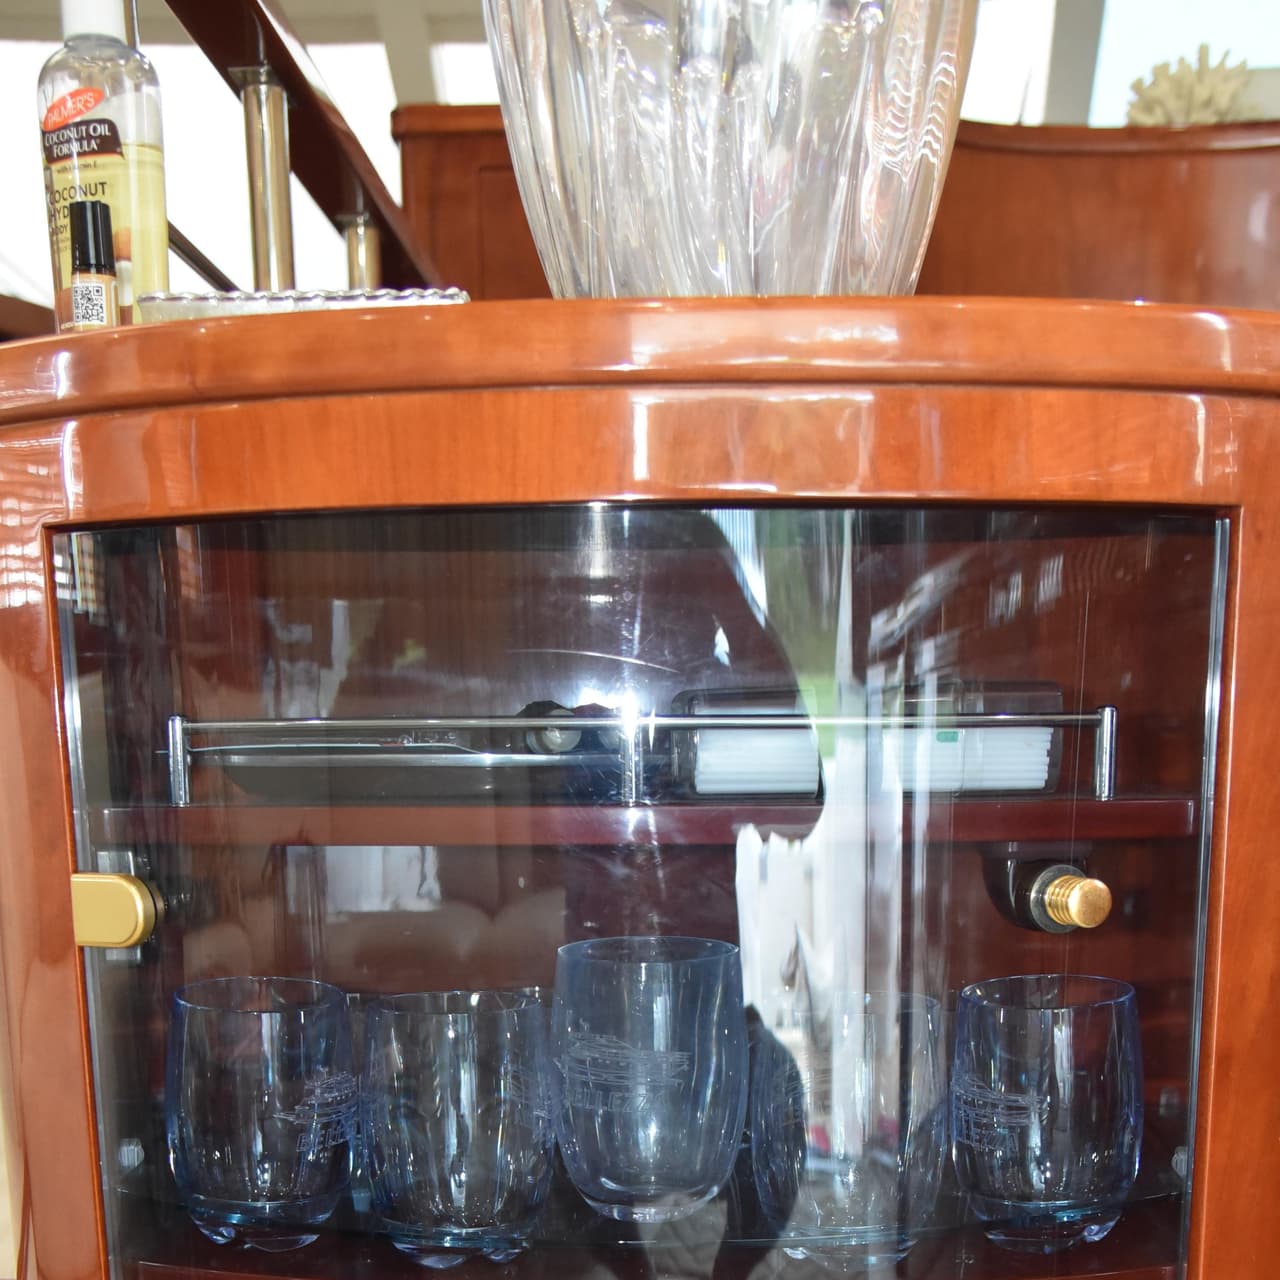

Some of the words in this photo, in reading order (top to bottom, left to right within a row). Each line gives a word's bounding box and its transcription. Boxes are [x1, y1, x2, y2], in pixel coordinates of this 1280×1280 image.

[47, 92, 95, 129] PALMER'S
[45, 126, 86, 147] COCONUT
[89, 123, 111, 137] OIL
[53, 138, 98, 158] FORMULA
[49, 182, 107, 206] COCONUT
